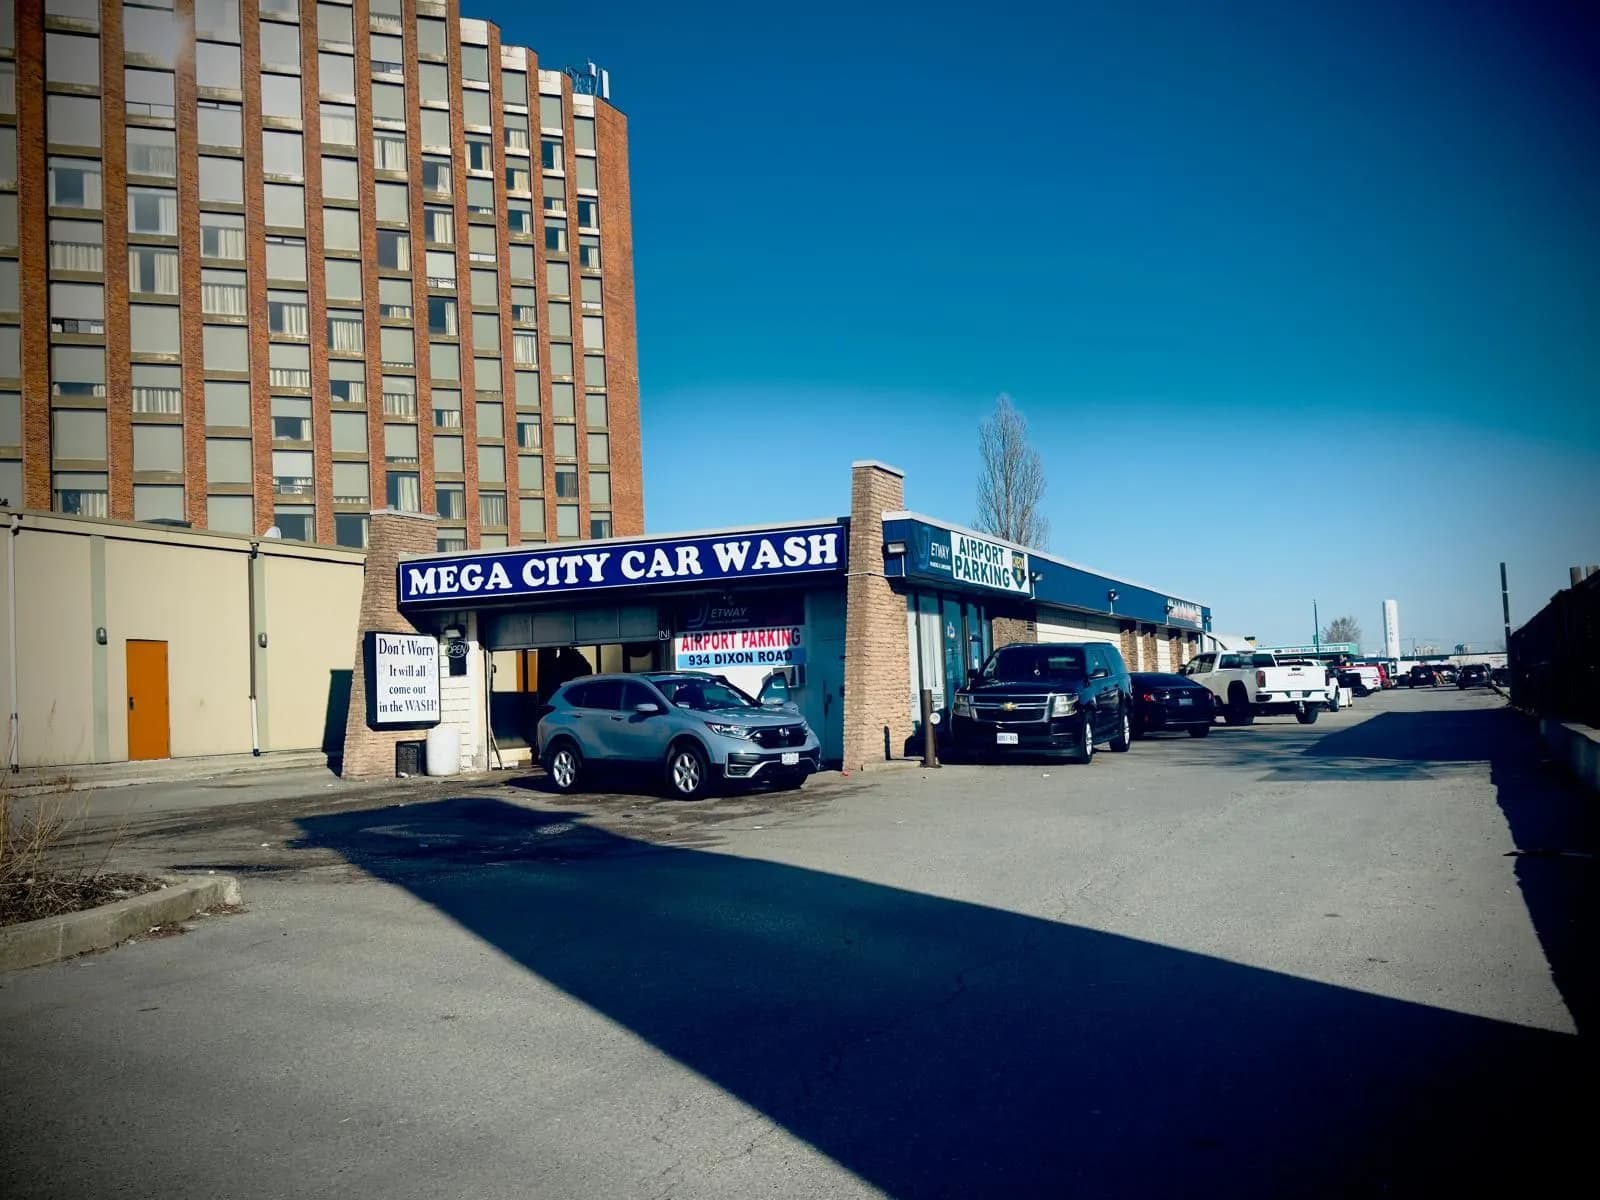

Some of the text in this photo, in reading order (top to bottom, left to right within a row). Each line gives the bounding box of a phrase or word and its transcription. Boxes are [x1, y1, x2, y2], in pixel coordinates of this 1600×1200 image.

[959, 536, 1004, 566] AIRPORT
[409, 533, 838, 595] MEGA CITY CAR WASH
[954, 555, 1010, 588] PARKING
[379, 638, 435, 659] Don't Worry
[682, 627, 801, 652] AIRPORT PARKING
[688, 650, 793, 666] 934 DIXON ROAD
[389, 664, 426, 677] It will all
[389, 686, 426, 695] come out
[379, 699, 437, 713] in the WASH!
